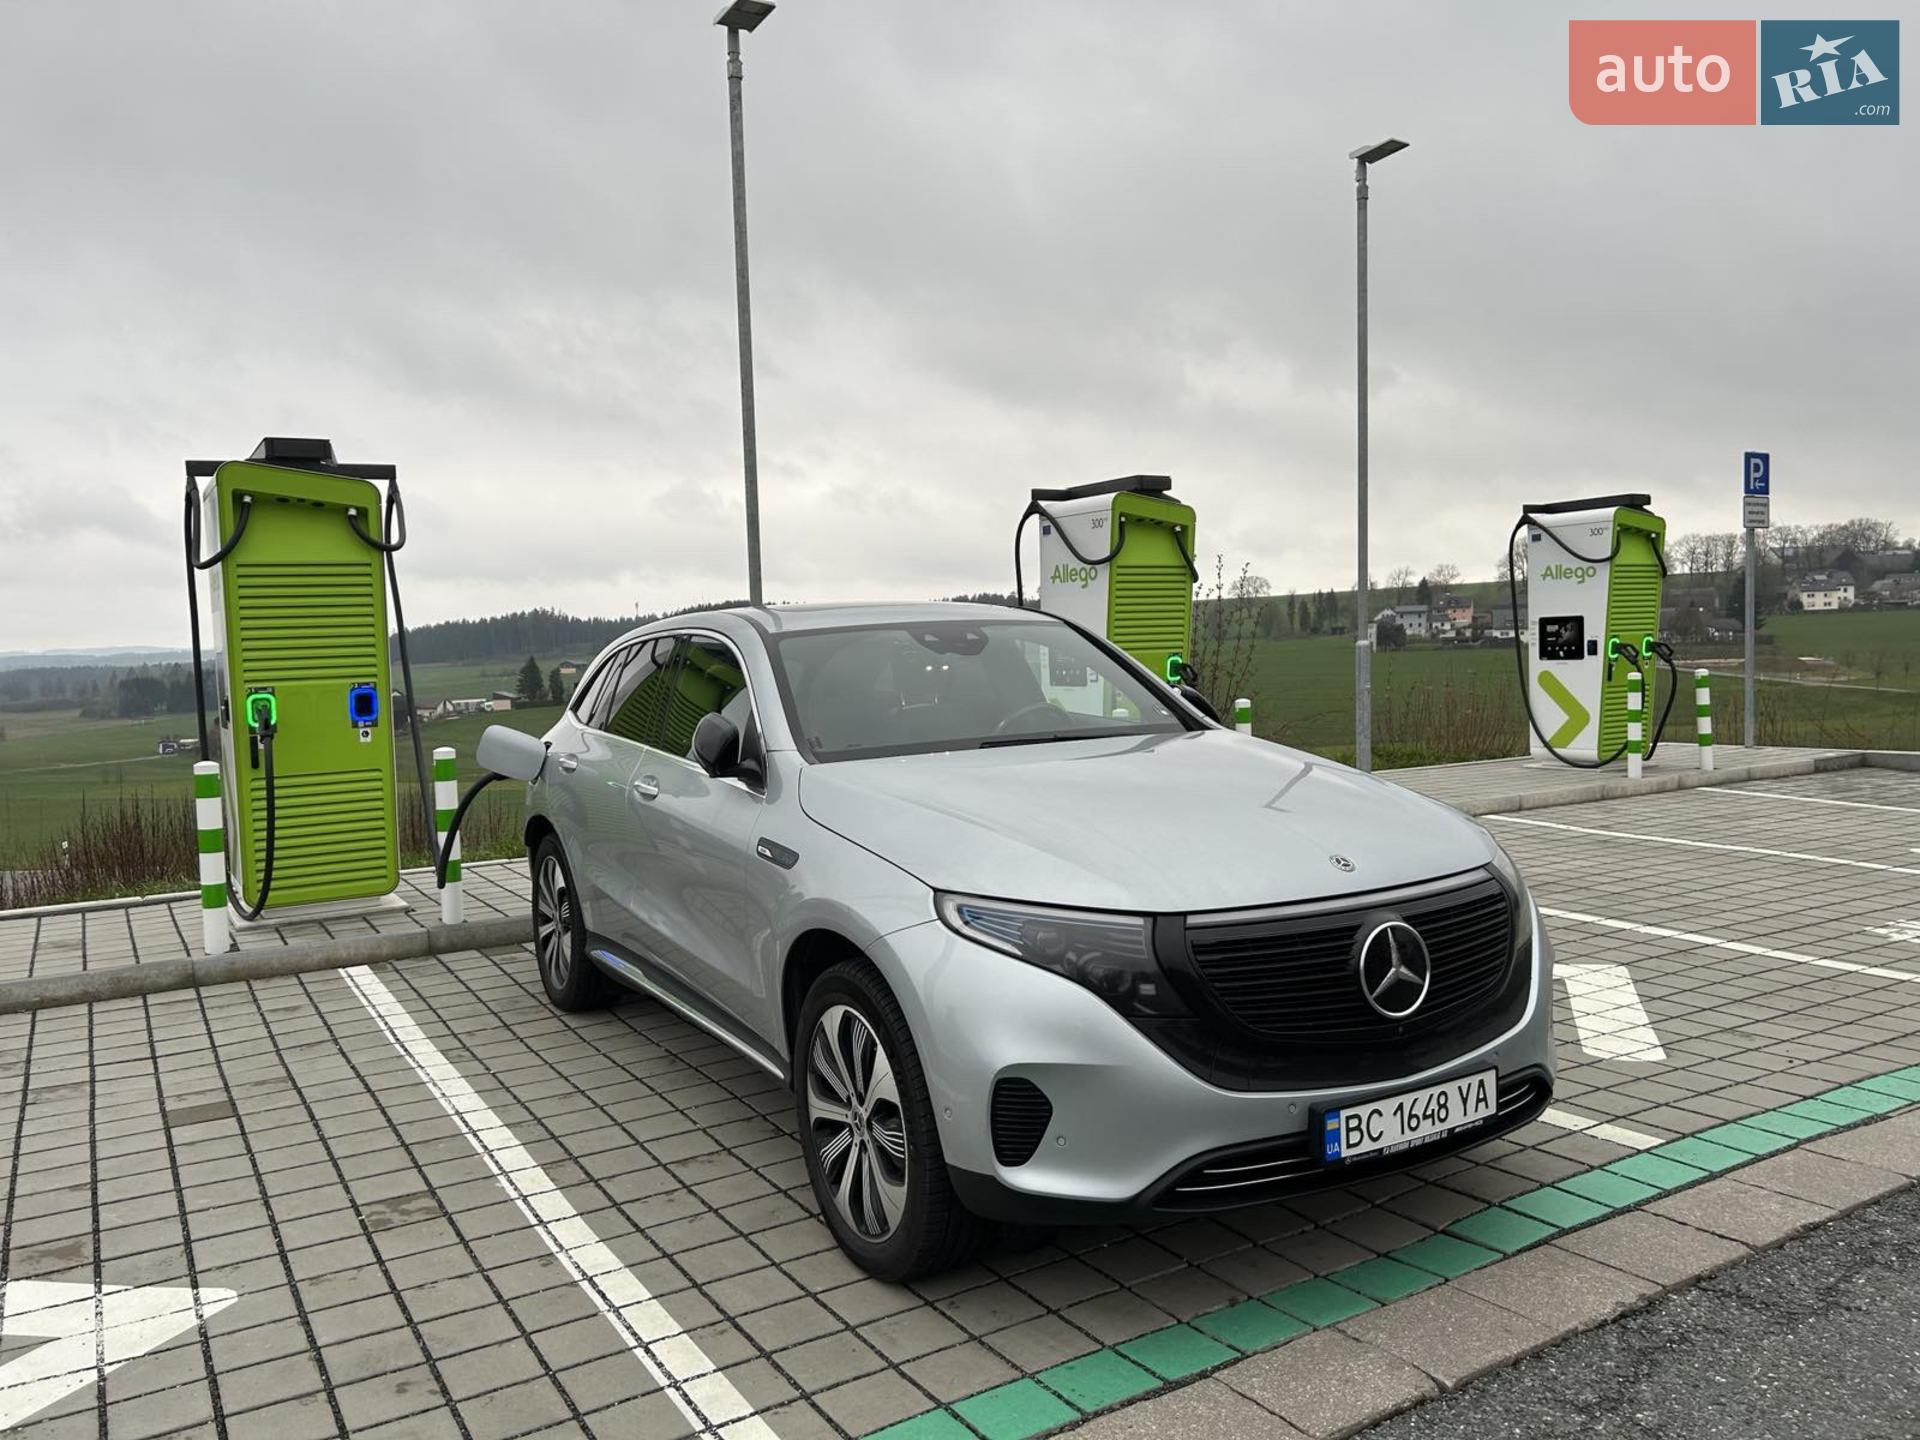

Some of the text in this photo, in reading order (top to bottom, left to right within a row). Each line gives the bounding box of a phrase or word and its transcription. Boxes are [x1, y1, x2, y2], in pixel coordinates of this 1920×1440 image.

[1749, 457, 1764, 490] P
[1050, 564, 1098, 588] Allego
[1540, 564, 1597, 584] Allego
[1345, 1108, 1384, 1149] BC
[1393, 1090, 1449, 1135] 1648
[1457, 1078, 1489, 1117] YA
[1326, 1142, 1340, 1155] UA
